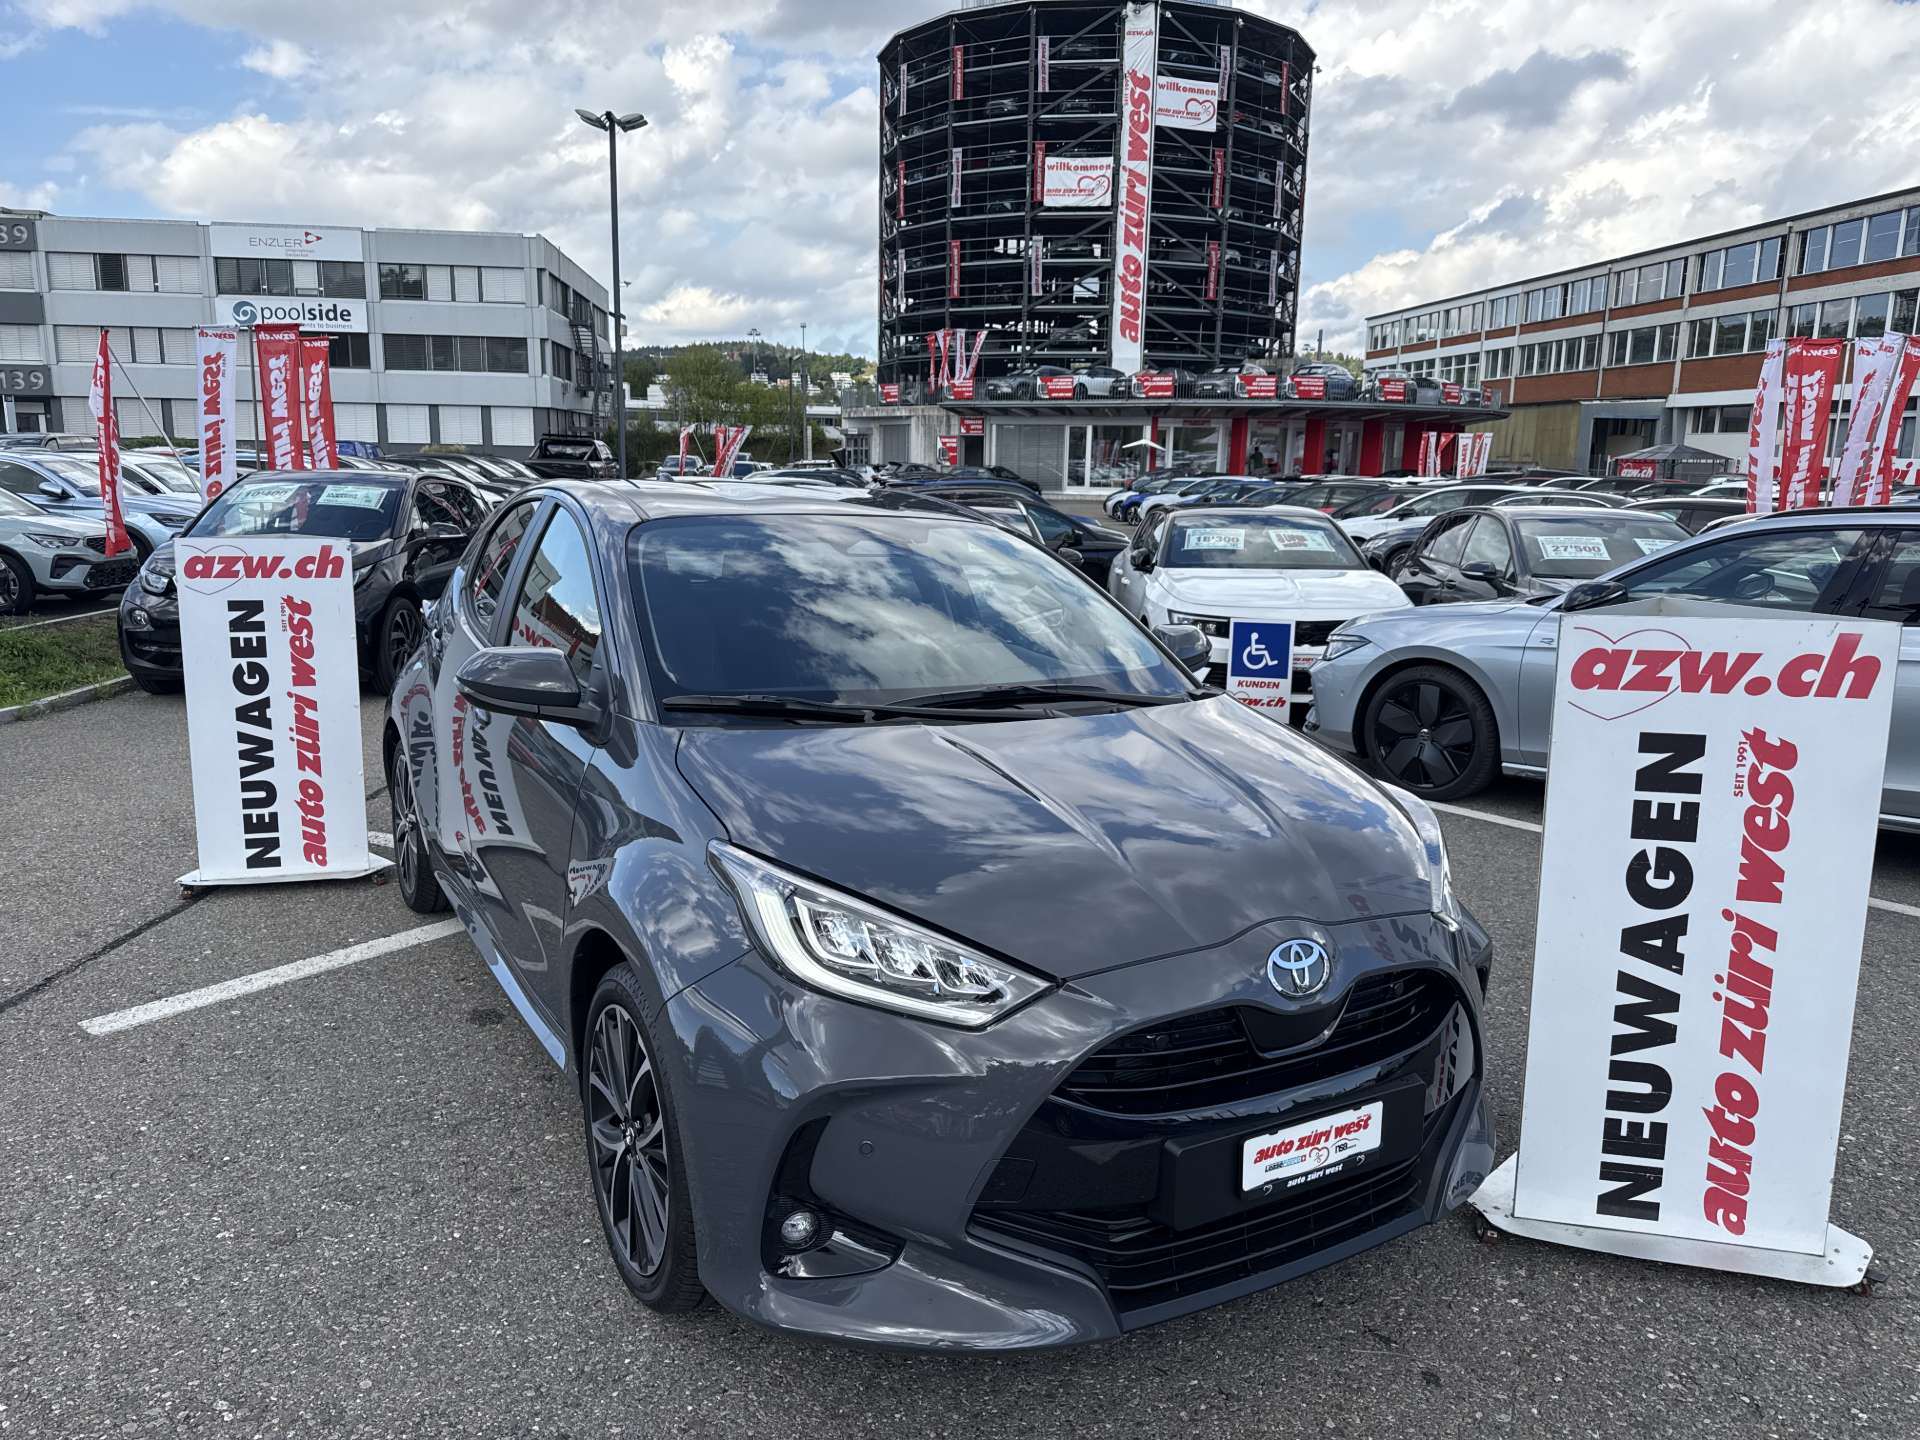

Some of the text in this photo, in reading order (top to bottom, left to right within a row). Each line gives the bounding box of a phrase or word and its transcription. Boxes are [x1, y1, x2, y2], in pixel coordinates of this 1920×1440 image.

[1158, 82, 1216, 96] willkommen
[1047, 162, 1111, 172] willkommen
[1117, 69, 1151, 343] auto züri west
[249, 237, 302, 248] ENZLER
[261, 302, 352, 324] poolside
[183, 545, 345, 580] azw.ch
[1237, 680, 1280, 689] KUNDEN
[1570, 633, 1882, 700] azw.ch
[227, 599, 282, 869] NEUWAGEN
[281, 594, 328, 867] auto züri west
[1733, 741, 1748, 797] SEIT 1991
[1596, 732, 1707, 1222] NEUWAGEN
[1701, 727, 1798, 1236] auto züri west
[1254, 1115, 1371, 1164] auto züri west
[1287, 1163, 1344, 1187] auto züri west
